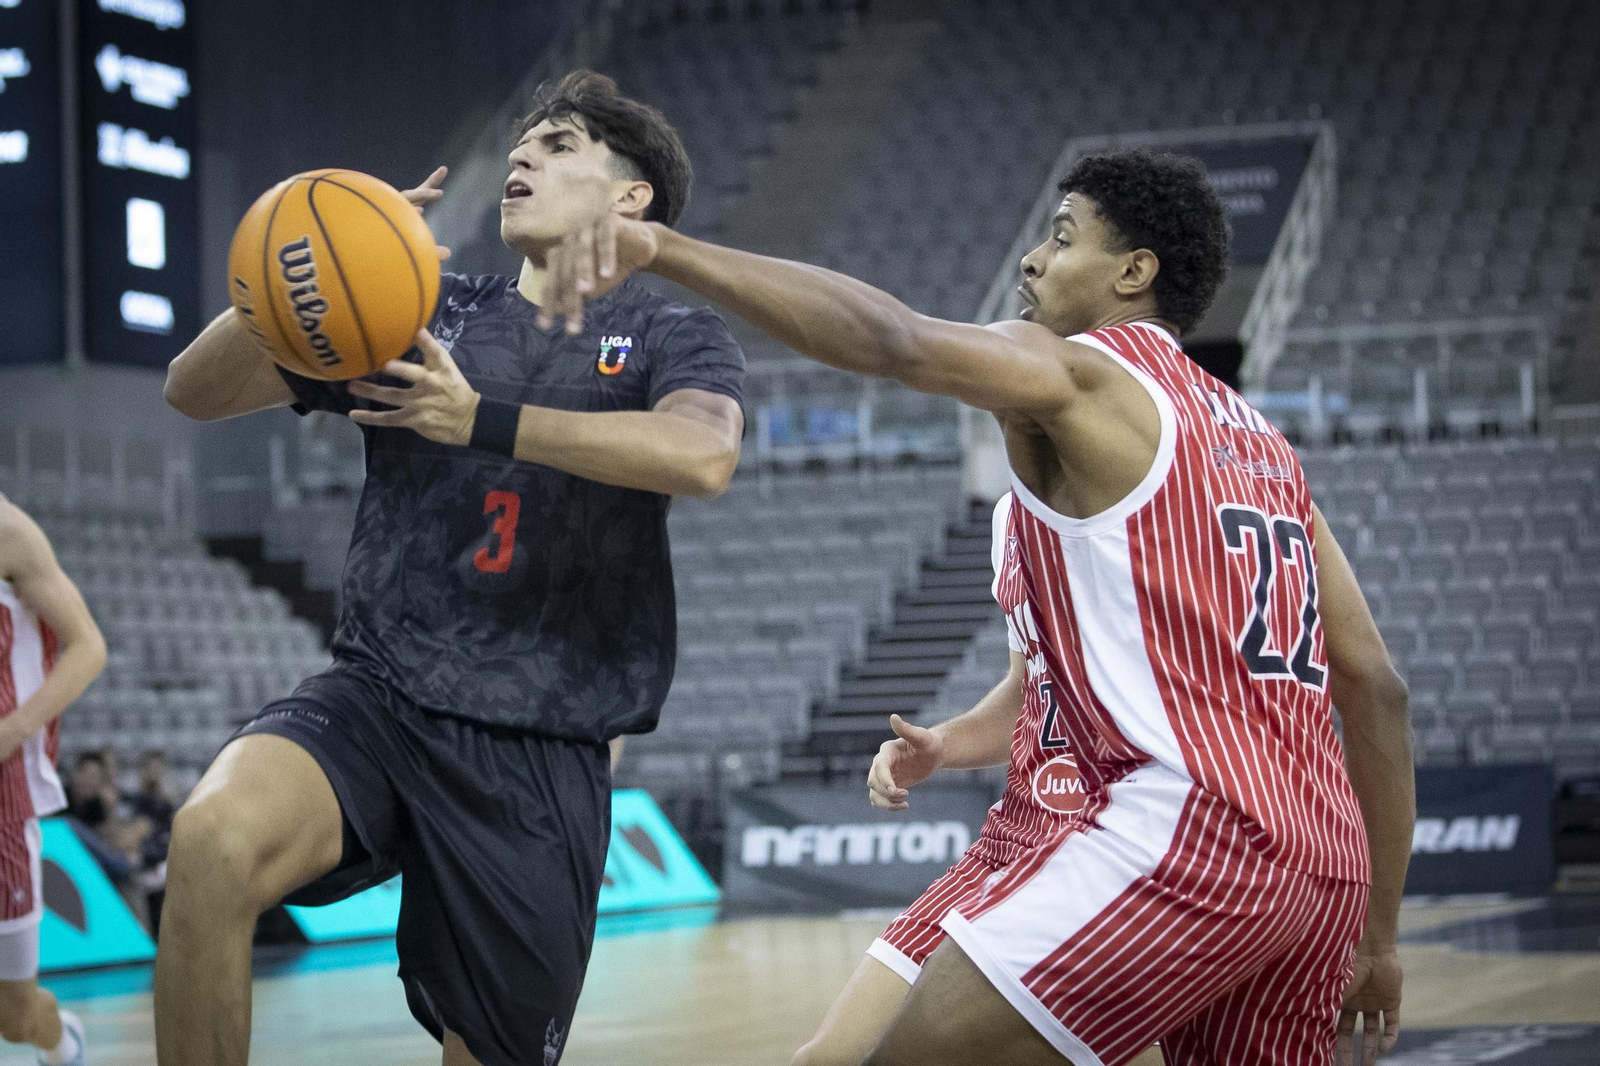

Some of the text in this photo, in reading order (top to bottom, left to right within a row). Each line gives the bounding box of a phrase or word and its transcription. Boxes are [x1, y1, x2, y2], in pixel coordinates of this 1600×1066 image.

[277, 235, 343, 367] Wilson
[600, 335, 632, 348] LIGA
[473, 490, 521, 573] 3
[1216, 503, 1329, 693] 22
